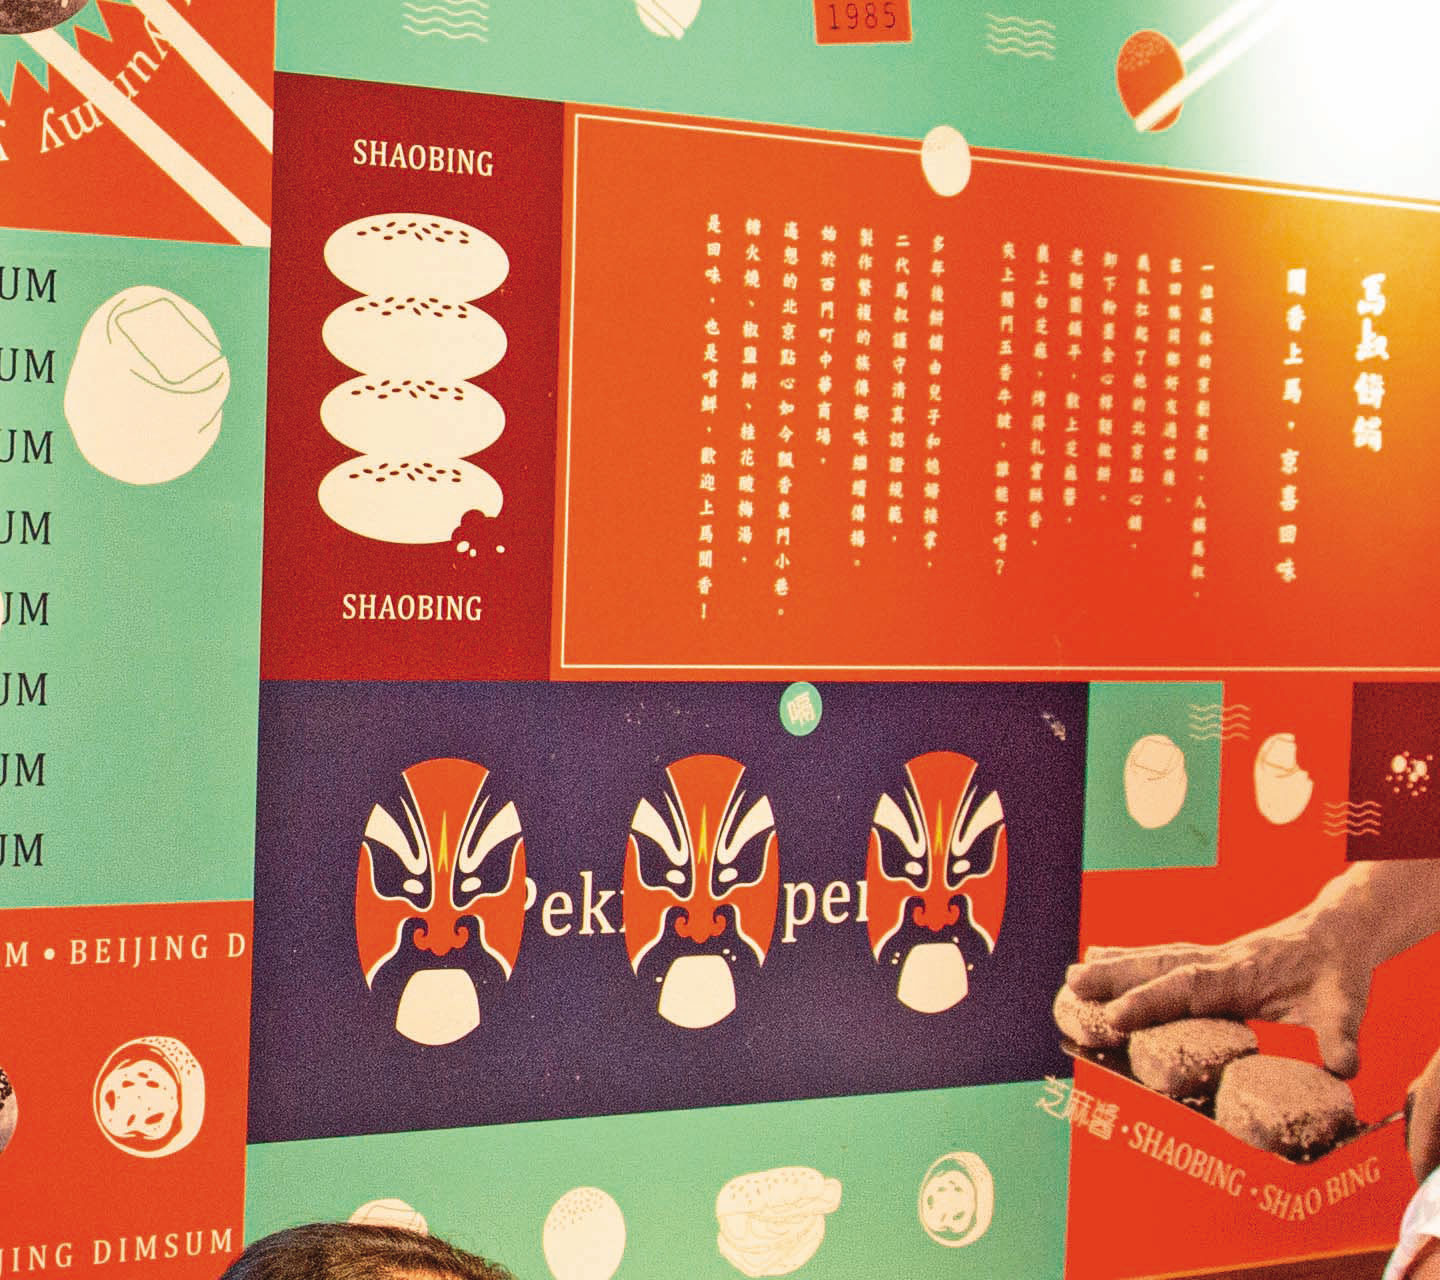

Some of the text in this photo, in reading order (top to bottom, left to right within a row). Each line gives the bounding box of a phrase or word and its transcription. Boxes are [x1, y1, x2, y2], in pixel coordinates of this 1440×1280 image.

[827, 0, 897, 31] 1985
[352, 138, 494, 177] SHAOBING
[341, 593, 483, 622] SHAOBING
[69, 933, 210, 969] BEIJING
[1126, 1121, 1245, 1198] SHAOBING
[92, 1227, 235, 1264] DIMSUM
